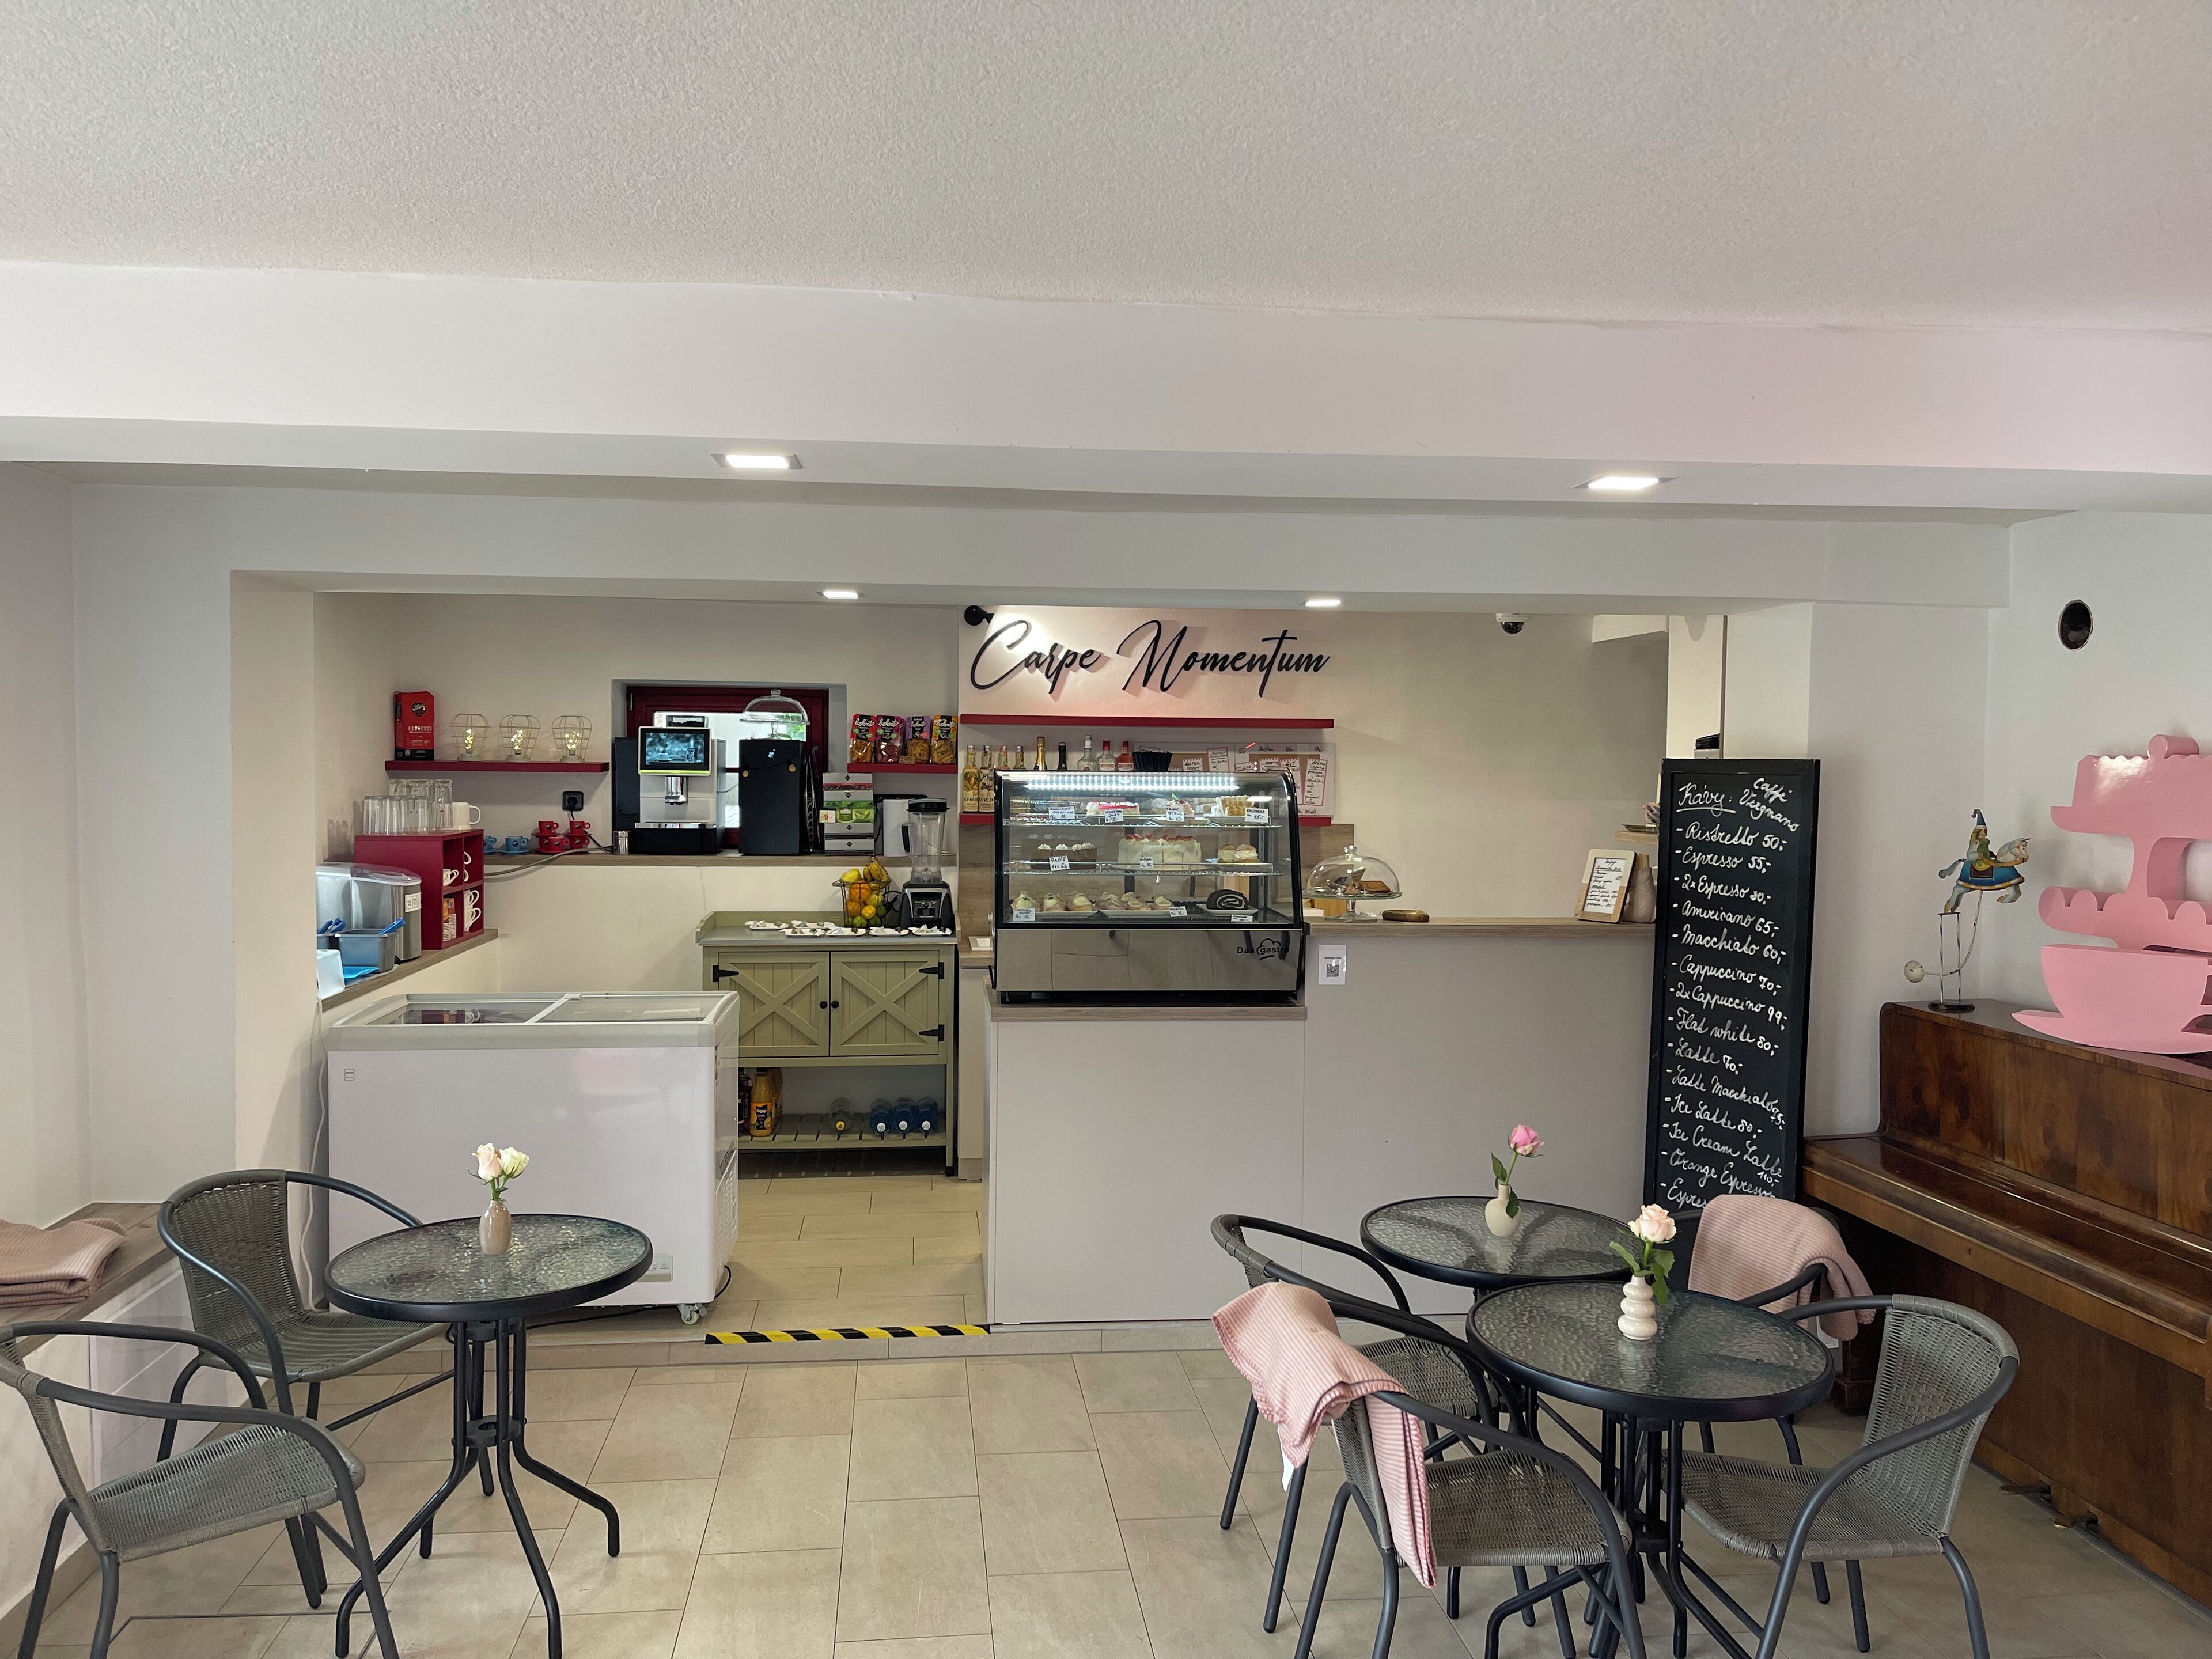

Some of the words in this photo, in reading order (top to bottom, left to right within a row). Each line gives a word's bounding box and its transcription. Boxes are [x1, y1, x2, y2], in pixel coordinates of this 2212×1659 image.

[970, 620, 1102, 694] Carpe
[1116, 620, 1330, 698] Momentum
[1685, 821, 1759, 846] Ristretto
[1682, 846, 1743, 870] Espresso
[1698, 875, 1750, 900] Espresso
[1681, 900, 1756, 927] Americano
[1260, 946, 1289, 955] gastro
[1681, 924, 1760, 955] Macchiato
[1679, 954, 1757, 983] Cappuccino
[1692, 985, 1766, 1012] Cappuccino
[1676, 1007, 1709, 1034] Flat
[1675, 1037, 1720, 1064] Latte
[1672, 1065, 1707, 1092] Latte
[1711, 1075, 1778, 1112] Macchiato
[1671, 1093, 1692, 1113] Ice
[1695, 1101, 1736, 1130] Latte
[1669, 1122, 1689, 1142] Ice
[1692, 1125, 1741, 1157] Cream
[1743, 1140, 1782, 1177] Latte
[1669, 1147, 1718, 1188] Orange
